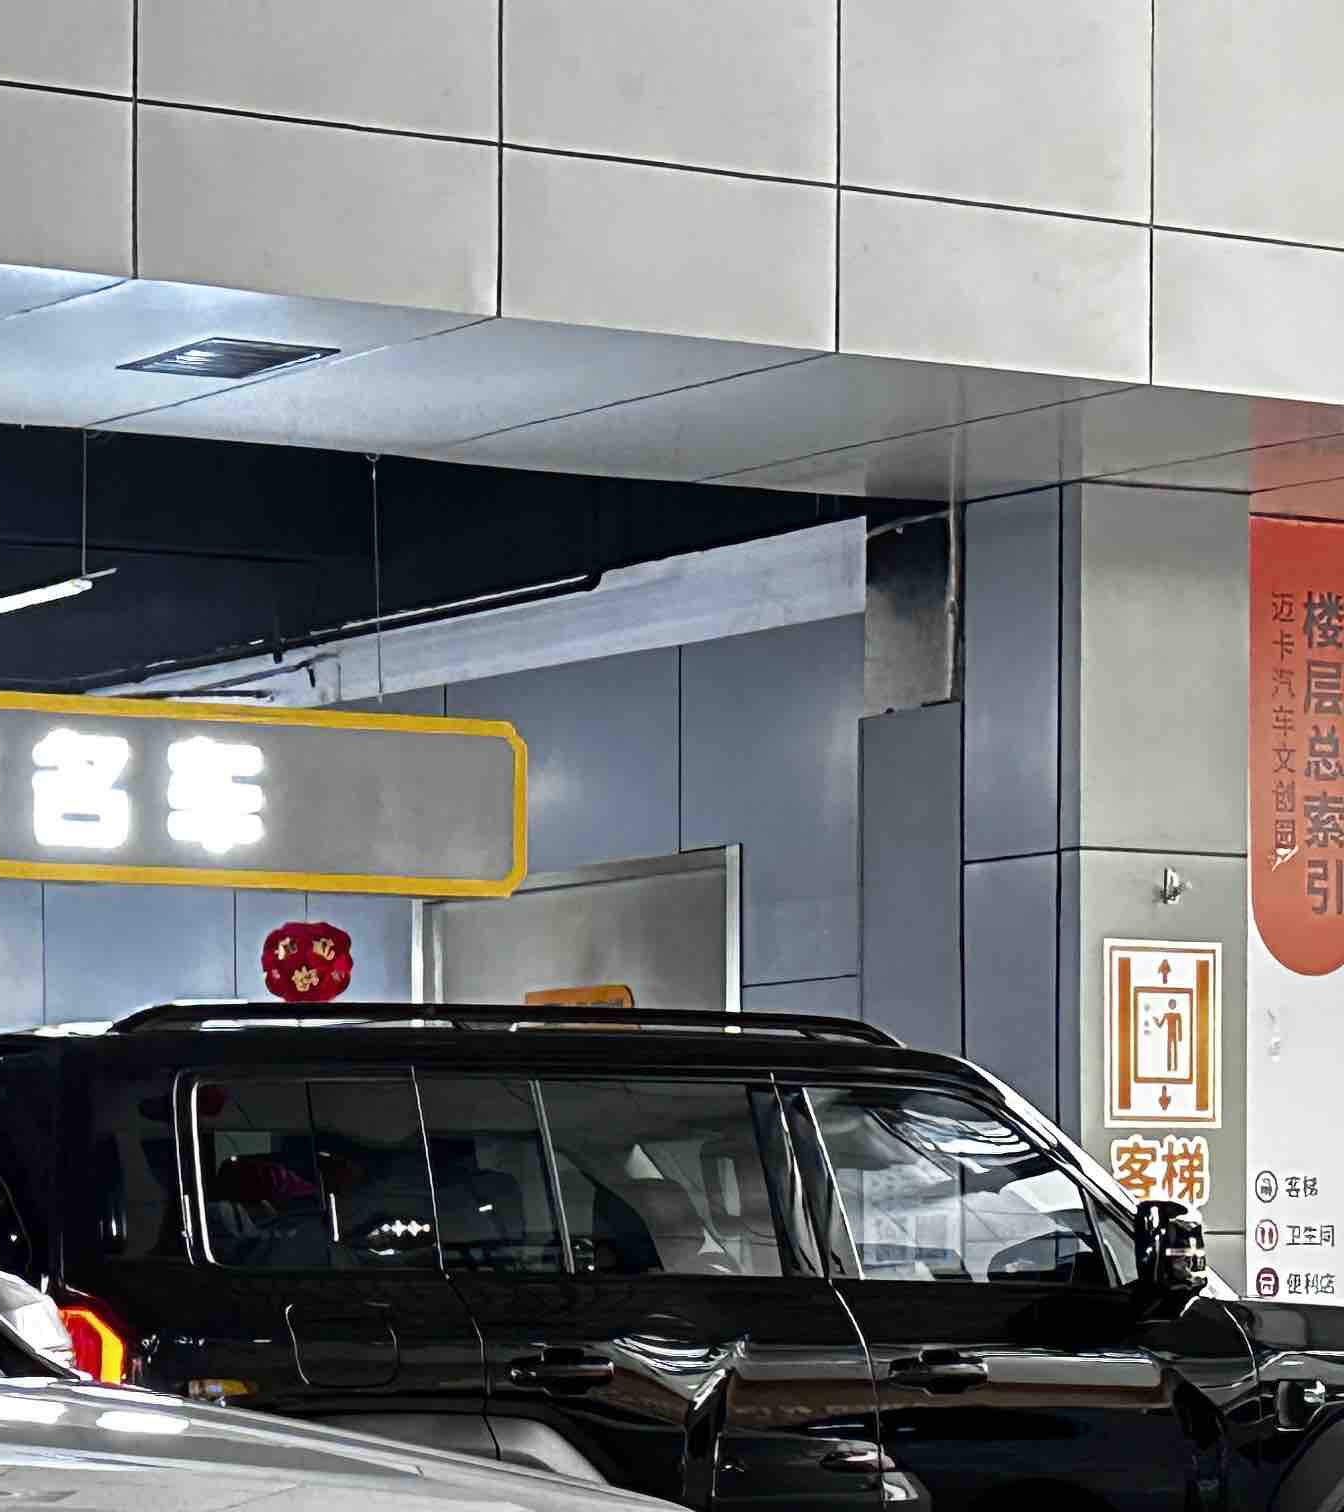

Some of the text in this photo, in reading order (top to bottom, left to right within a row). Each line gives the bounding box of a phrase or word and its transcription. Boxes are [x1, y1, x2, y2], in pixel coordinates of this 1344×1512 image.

[1302, 589, 1344, 916] 楼层总索引
[1116, 1141, 1205, 1204] 客梯
[1285, 1224, 1335, 1248] 卫生间
[1286, 1272, 1336, 1295] 便利店
